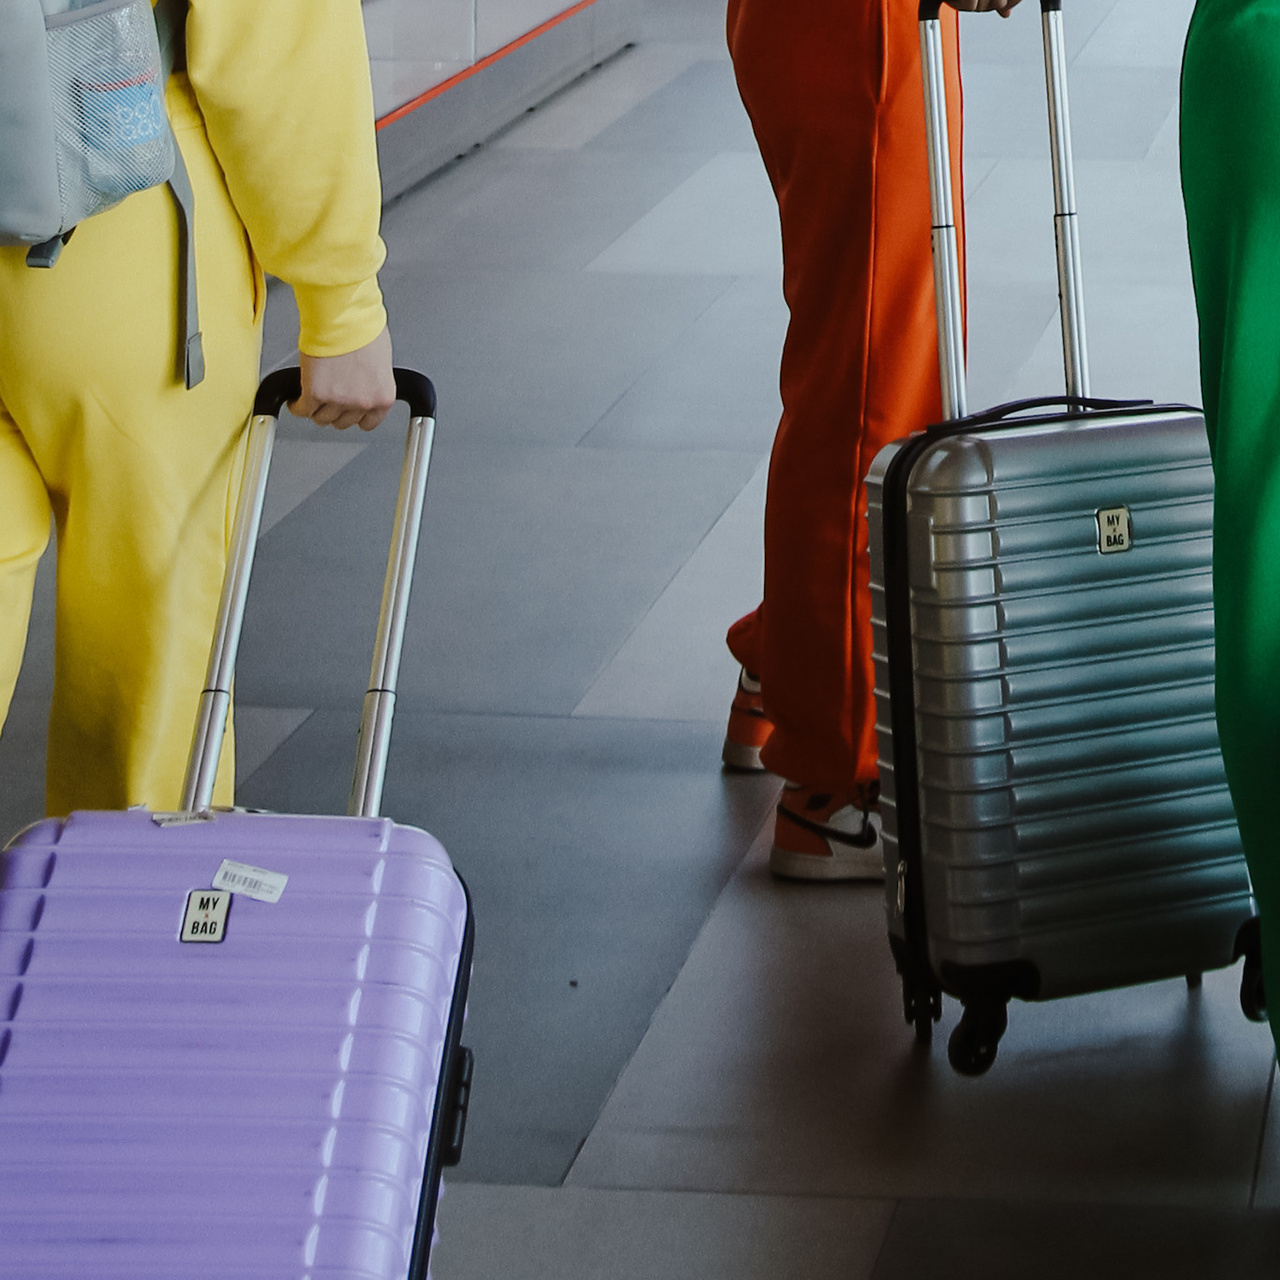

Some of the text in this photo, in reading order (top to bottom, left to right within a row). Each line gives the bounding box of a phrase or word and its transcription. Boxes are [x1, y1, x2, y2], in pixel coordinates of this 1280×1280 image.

[1106, 514, 1120, 527] MY
[1106, 534, 1124, 547] BAG
[199, 896, 220, 911] MY
[190, 920, 218, 935] BAG
